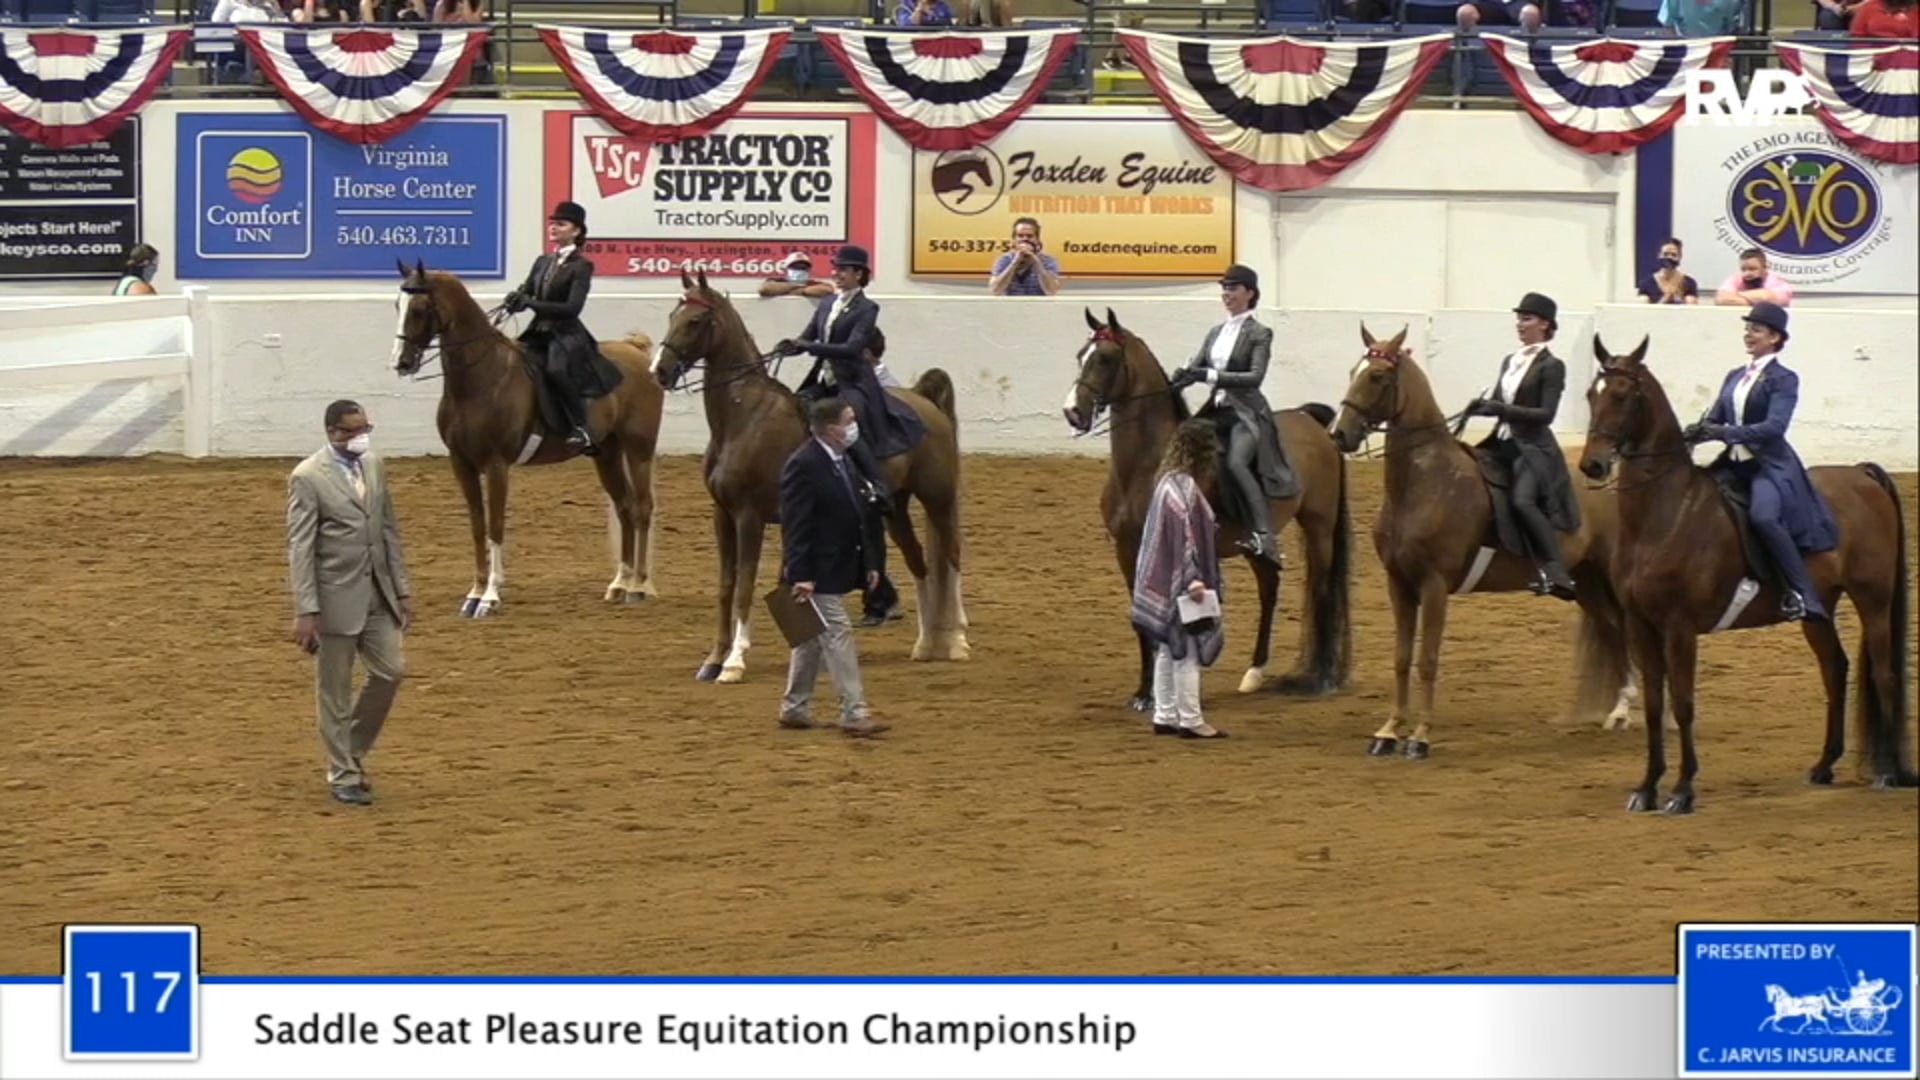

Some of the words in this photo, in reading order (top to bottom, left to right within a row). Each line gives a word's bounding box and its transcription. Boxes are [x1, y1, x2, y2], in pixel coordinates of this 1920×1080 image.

[361, 143, 449, 171] Virginia
[655, 133, 831, 166] TRACTOR
[1720, 145, 1750, 172] THE
[1752, 132, 1791, 151] EMO
[592, 138, 641, 186] TSC
[1008, 151, 1108, 189] Foxden
[1117, 152, 1216, 194] Equine
[333, 176, 396, 198] Horse
[403, 176, 478, 199] Center
[654, 169, 787, 202] SUPPLY
[207, 203, 302, 225] Comfort
[1009, 195, 1101, 213] NUTRITION
[1105, 196, 1146, 214] THAT
[1149, 196, 1215, 214] WORKS
[41, 220, 76, 235] Start
[655, 209, 830, 231] TractorSupply.com
[235, 227, 273, 242] INN
[337, 225, 470, 245] 540.463.7311
[928, 239, 1012, 252] 540-337-5
[1833, 216, 1893, 269] Coverages
[1063, 240, 1217, 255] foxdenequine.com
